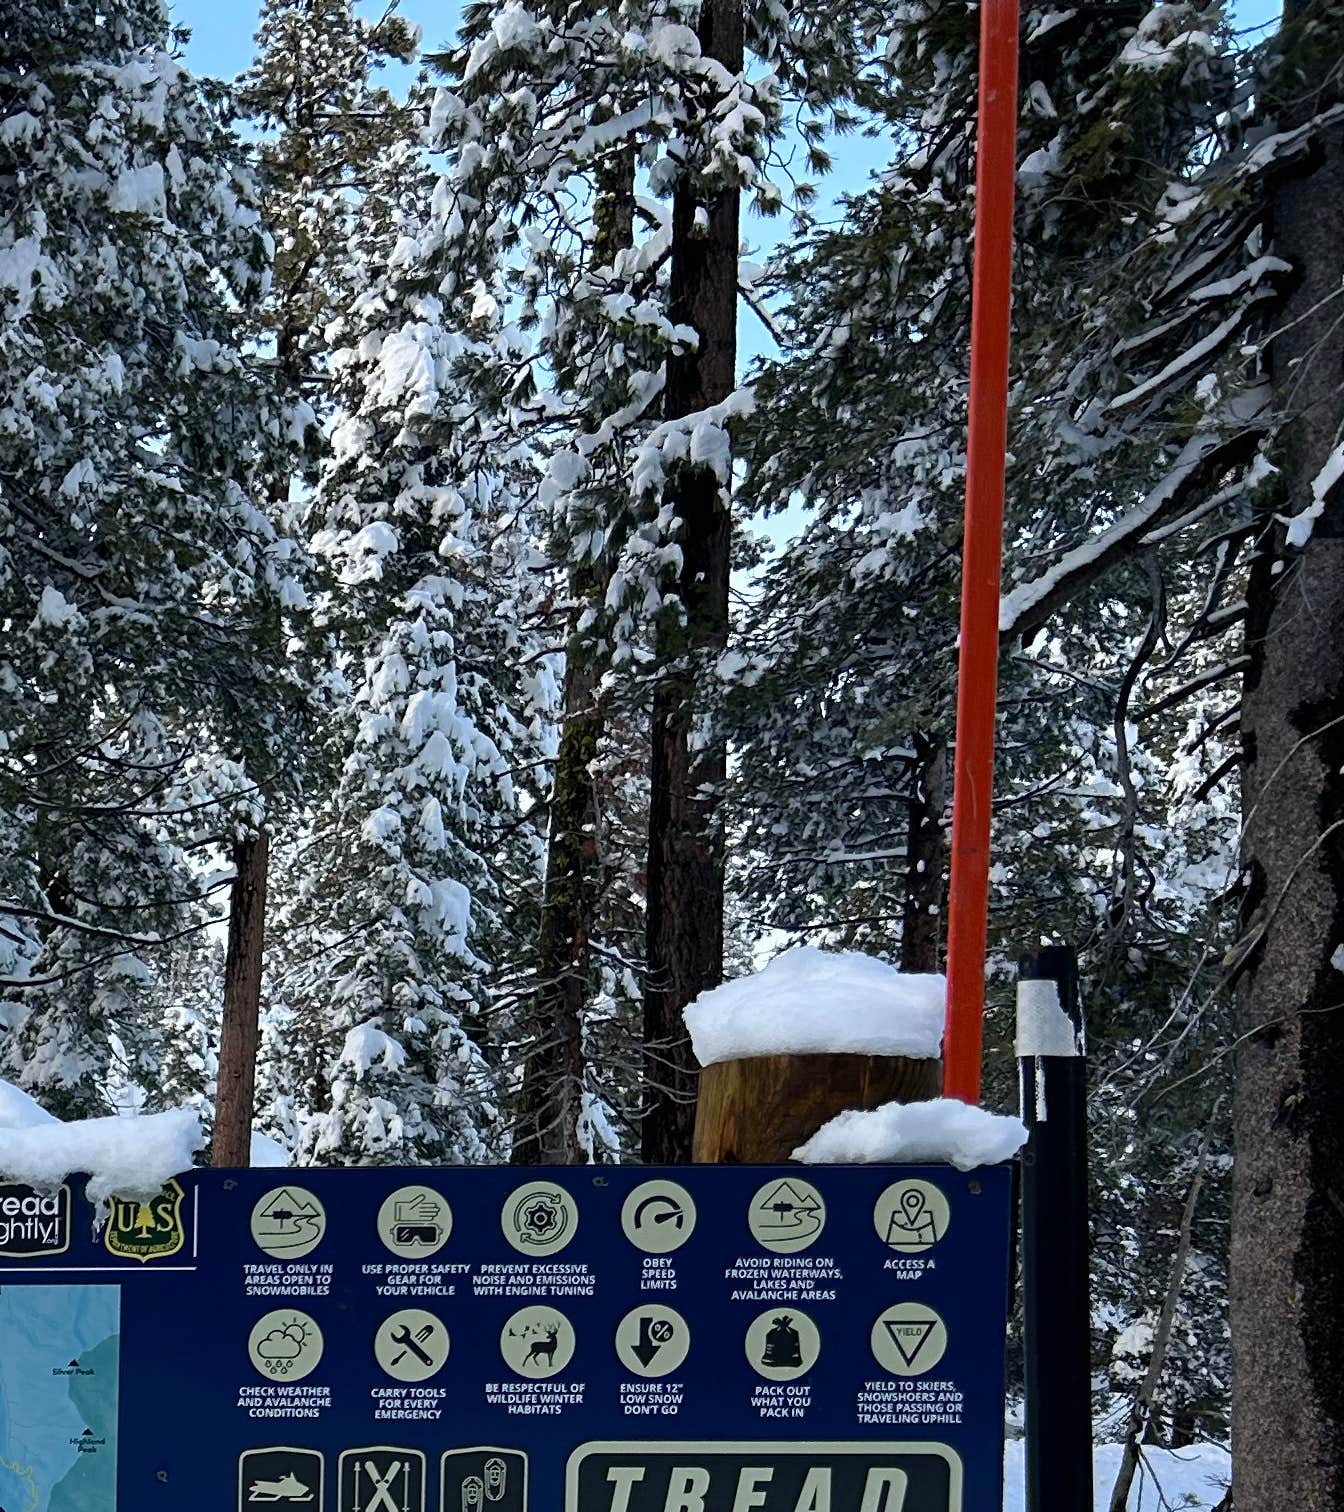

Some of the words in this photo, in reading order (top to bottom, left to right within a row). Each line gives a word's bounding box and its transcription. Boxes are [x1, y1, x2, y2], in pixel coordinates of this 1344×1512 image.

[643, 1259, 672, 1268] OBEY
[884, 1260, 922, 1270] ACCESS
[926, 1260, 935, 1269] A
[642, 1270, 676, 1279] SPEED
[896, 1271, 922, 1280] MAP
[640, 1280, 677, 1290] LIMITS
